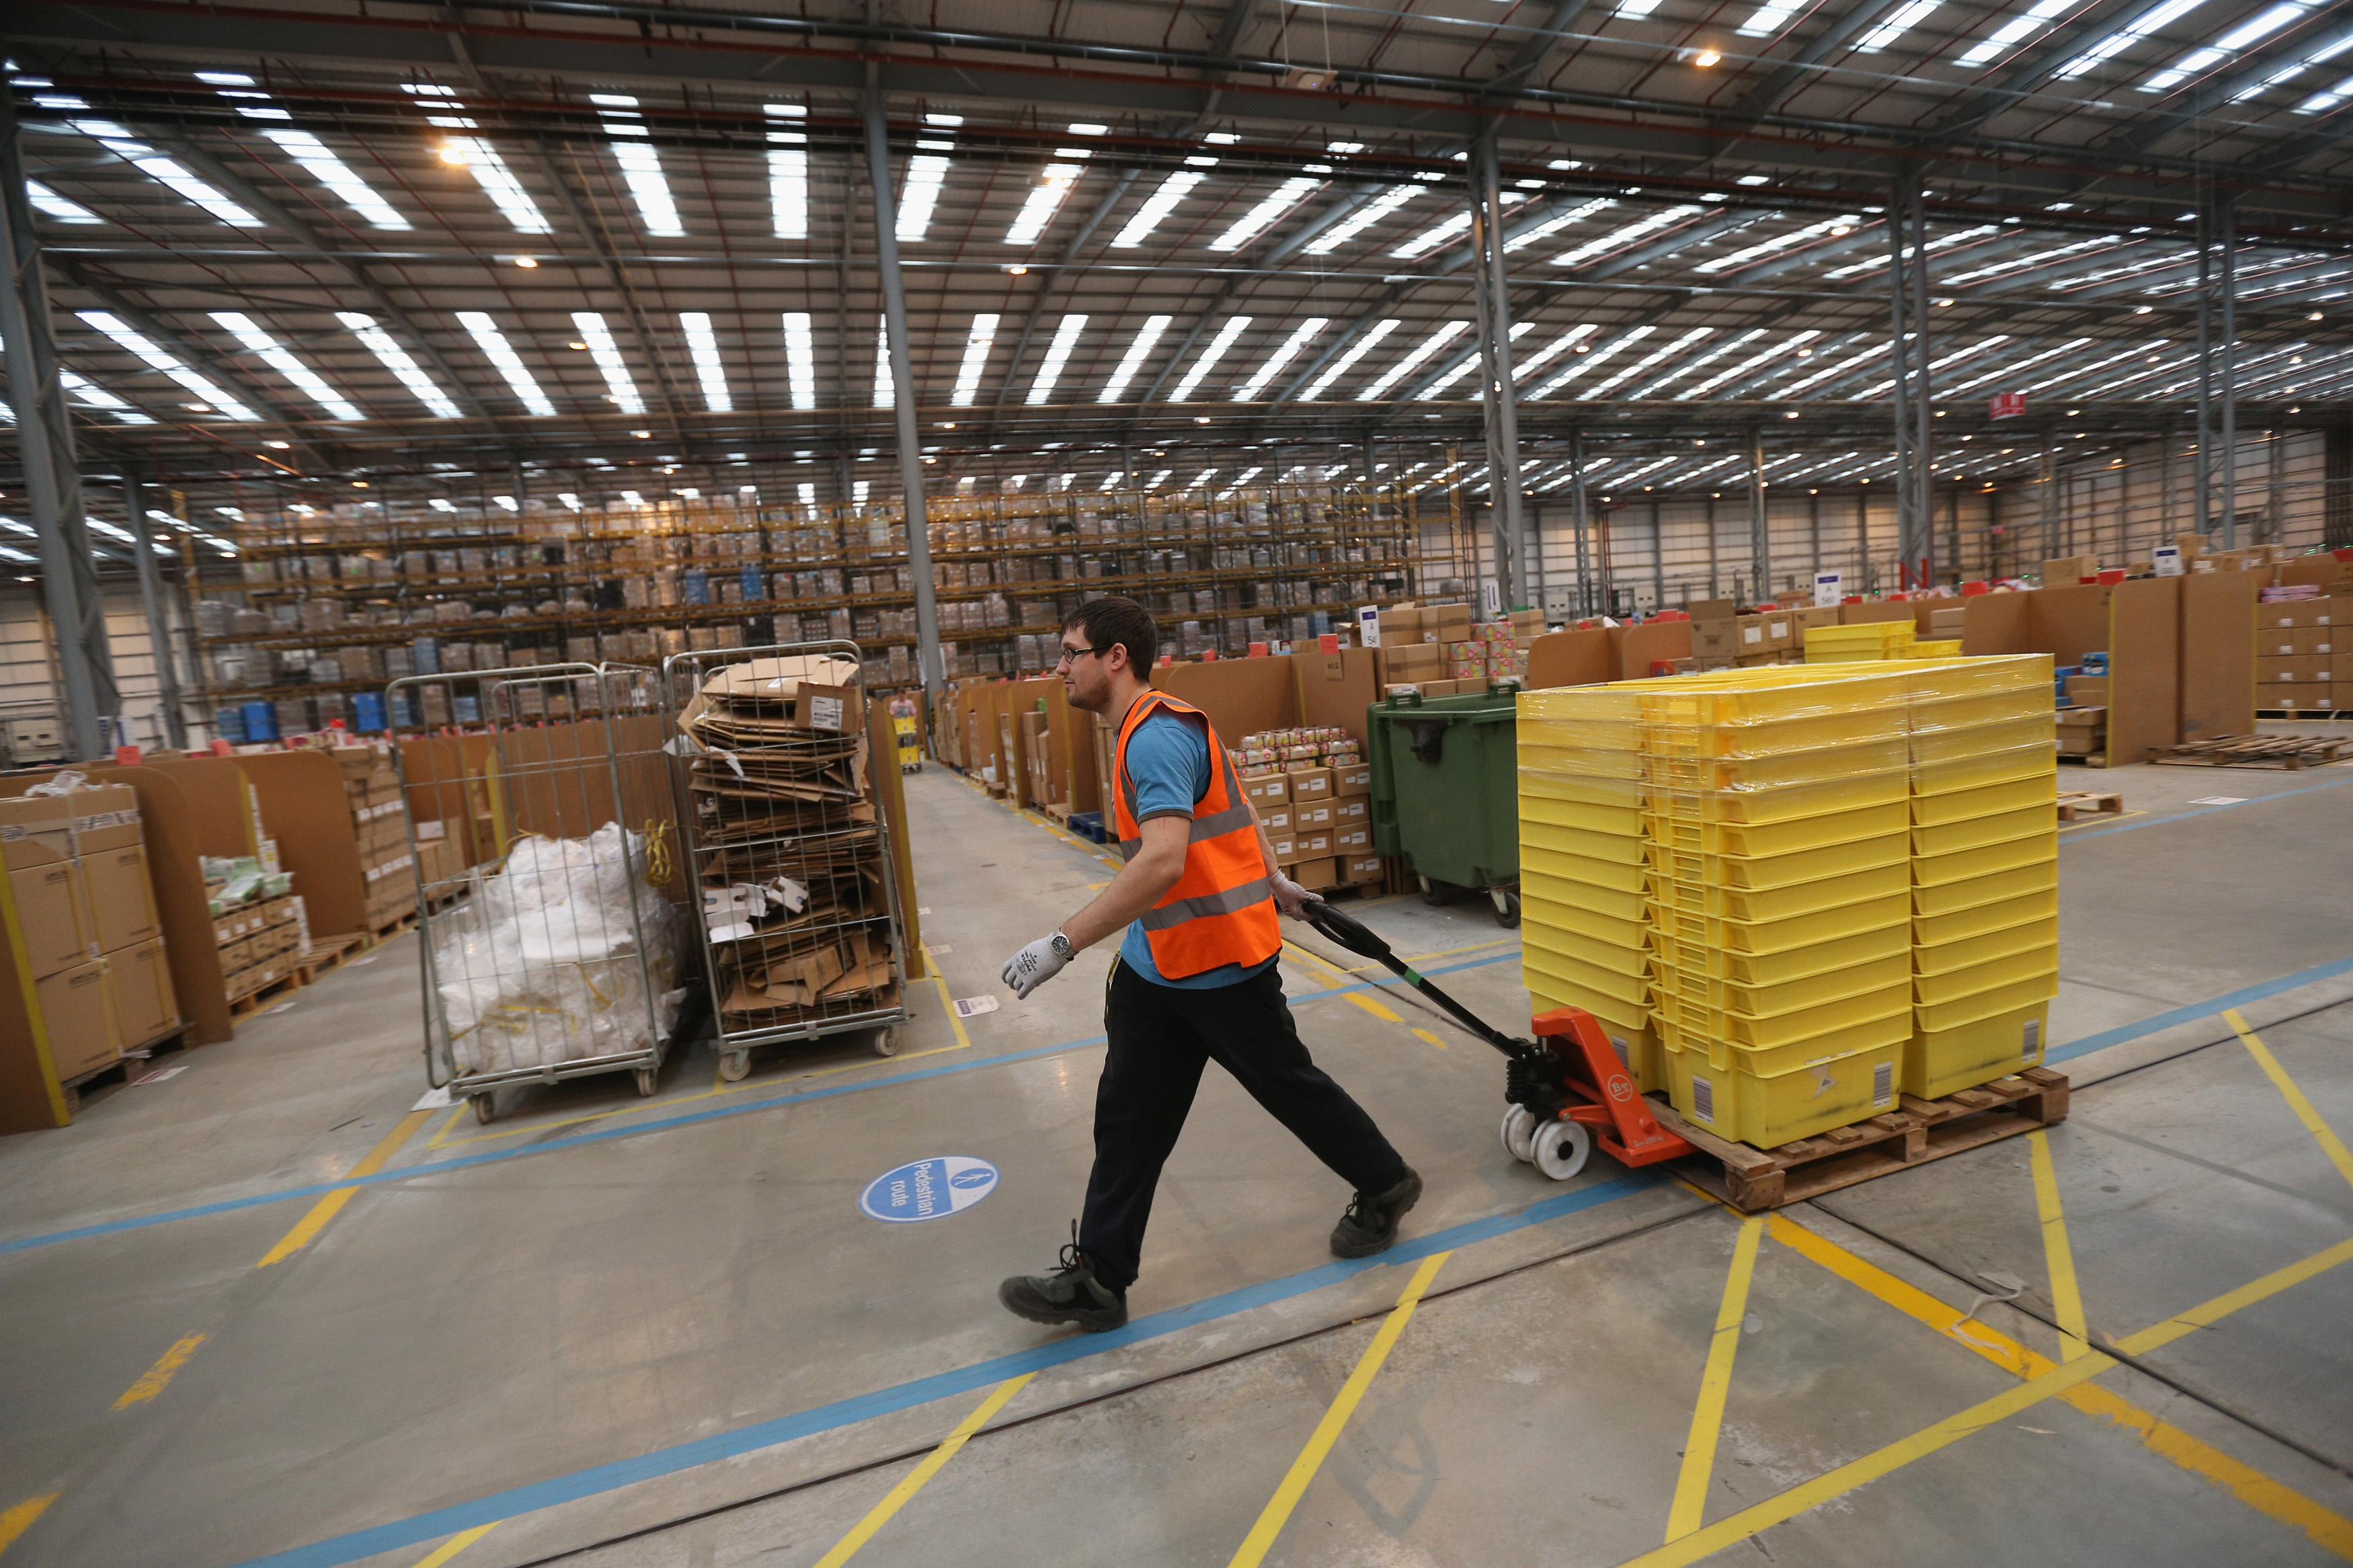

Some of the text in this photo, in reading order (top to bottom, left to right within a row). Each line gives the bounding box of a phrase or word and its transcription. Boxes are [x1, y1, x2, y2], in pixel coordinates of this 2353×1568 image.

[1611, 1082, 1630, 1093] BT
[891, 1180, 910, 1207] route
[914, 1162, 936, 1216] Pedestrian
